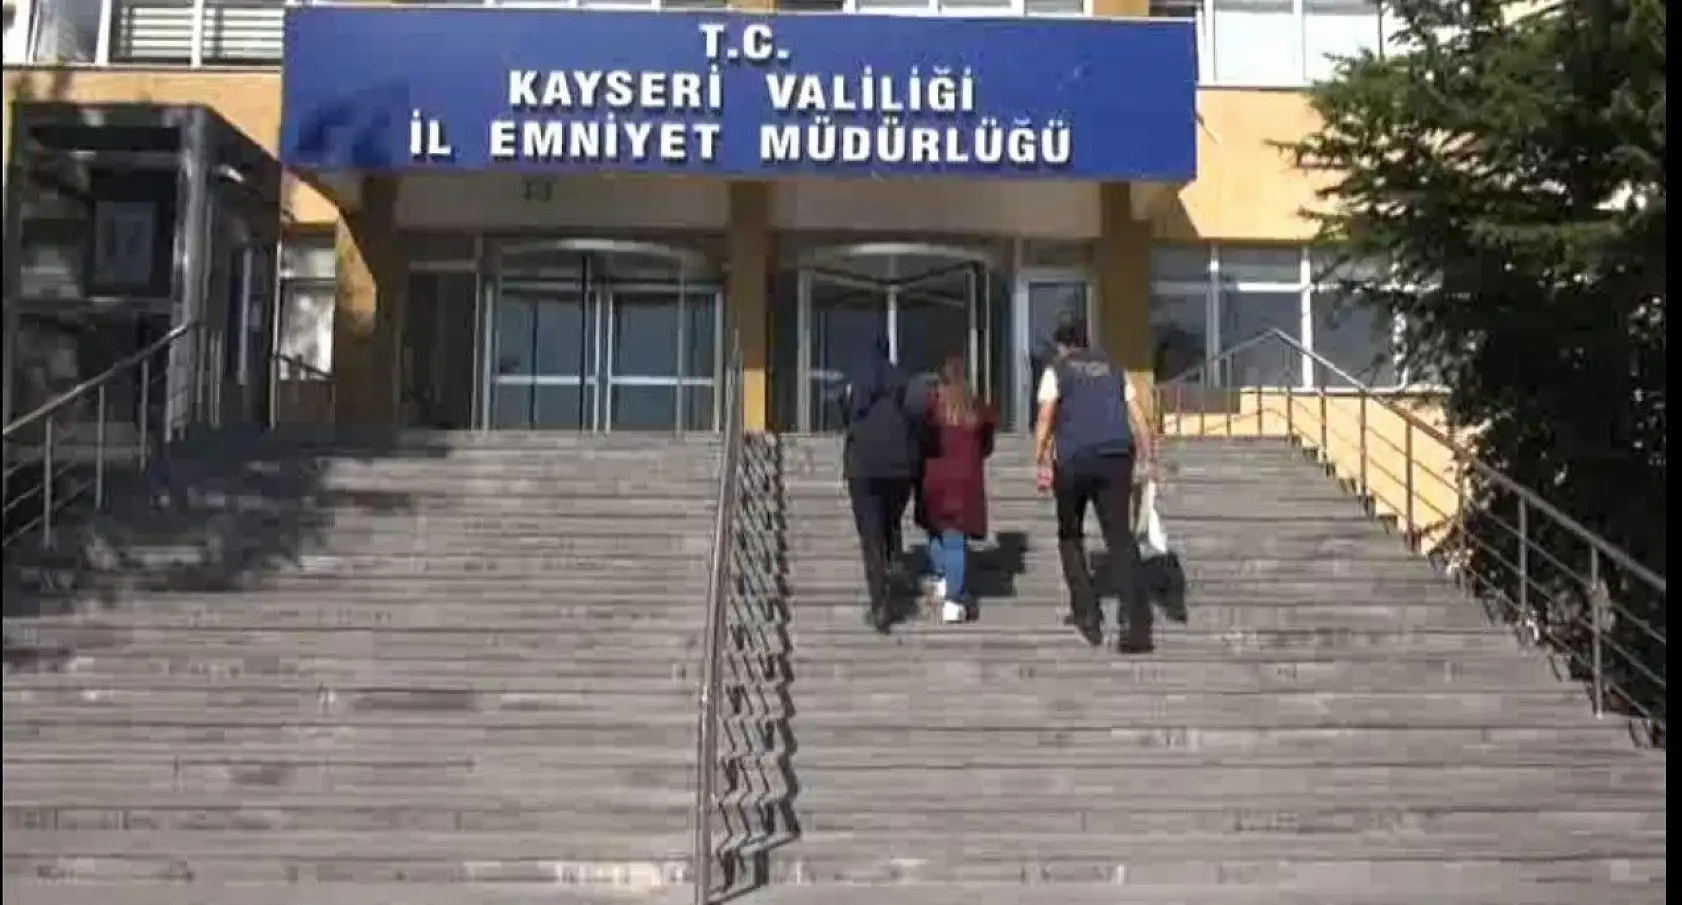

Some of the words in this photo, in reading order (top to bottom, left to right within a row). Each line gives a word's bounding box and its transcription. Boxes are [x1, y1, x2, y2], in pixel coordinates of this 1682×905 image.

[698, 24, 791, 58] T.C.
[508, 65, 722, 109] KAYSERİ
[766, 64, 976, 112] VALİLİĞİ
[409, 110, 452, 157] İL
[489, 114, 722, 159] EMNİYET
[759, 117, 1074, 164] MÜDÜRLÜĞÜ
